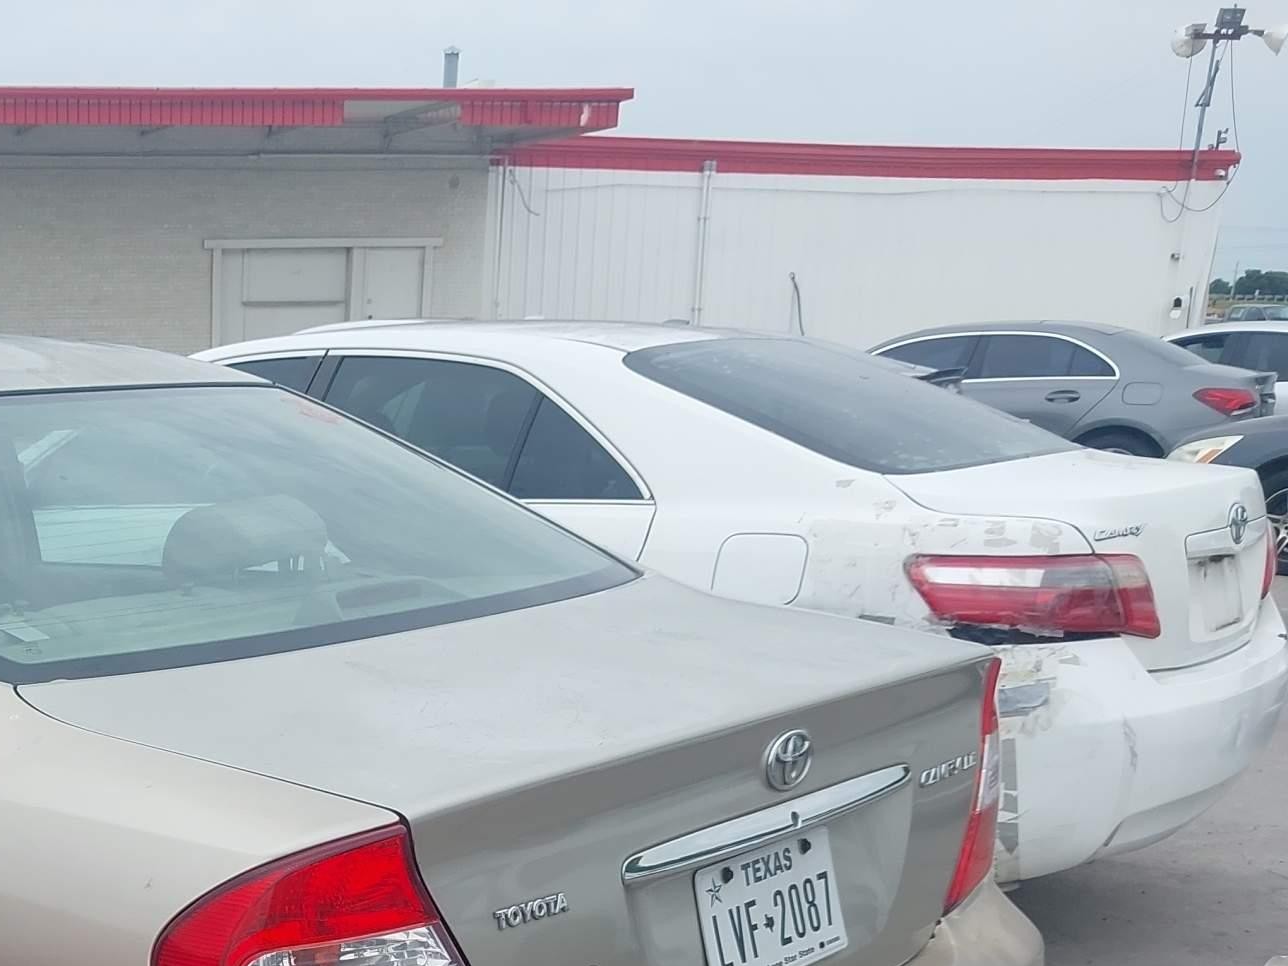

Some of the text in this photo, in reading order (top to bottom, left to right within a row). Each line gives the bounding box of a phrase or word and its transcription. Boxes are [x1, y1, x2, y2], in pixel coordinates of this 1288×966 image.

[741, 848, 792, 886] TEXAS
[493, 893, 569, 931] TOYOTA
[773, 871, 832, 946] 2087
[784, 955, 798, 965] Star
